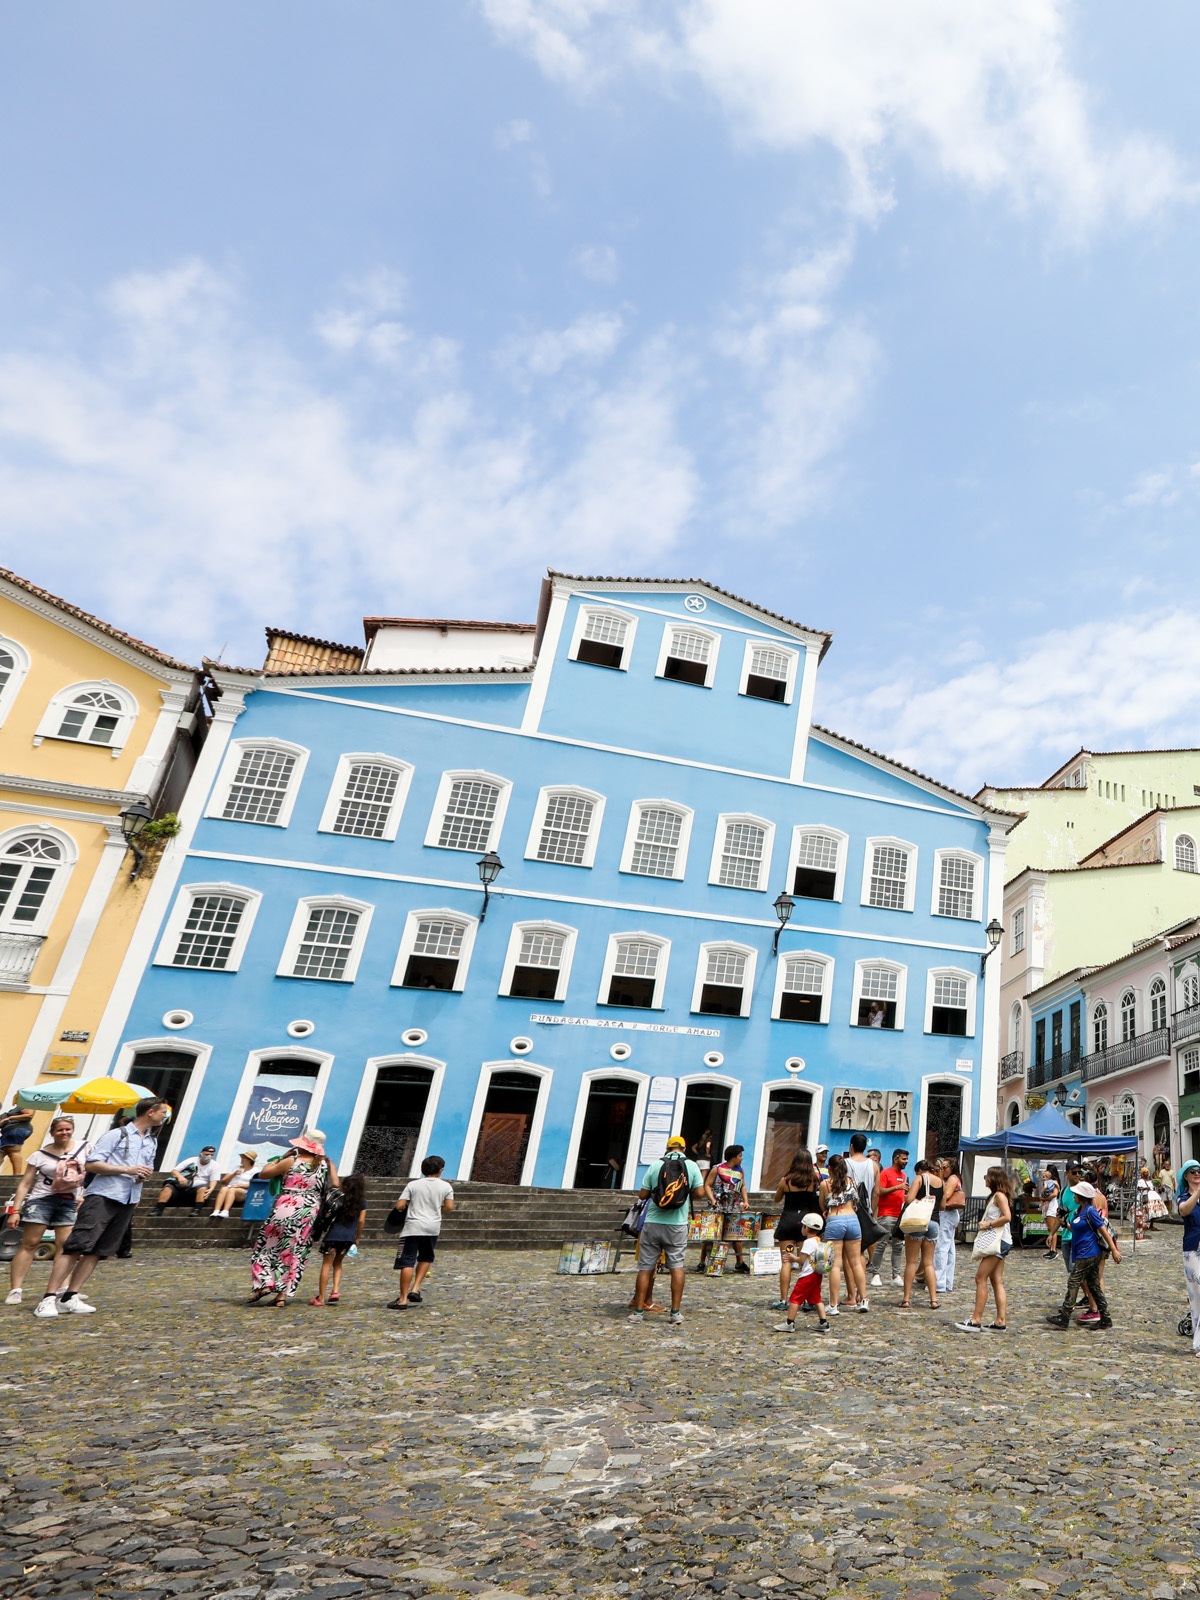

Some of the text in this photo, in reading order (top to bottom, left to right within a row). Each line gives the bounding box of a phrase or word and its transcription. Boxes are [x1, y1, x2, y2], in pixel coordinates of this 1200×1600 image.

[597, 1020, 625, 1029] CASA
[646, 1025, 679, 1033] JORGE
[686, 1028, 720, 1036] AMADO
[261, 1097, 298, 1111] Tenda
[248, 1108, 300, 1132] Milagres
